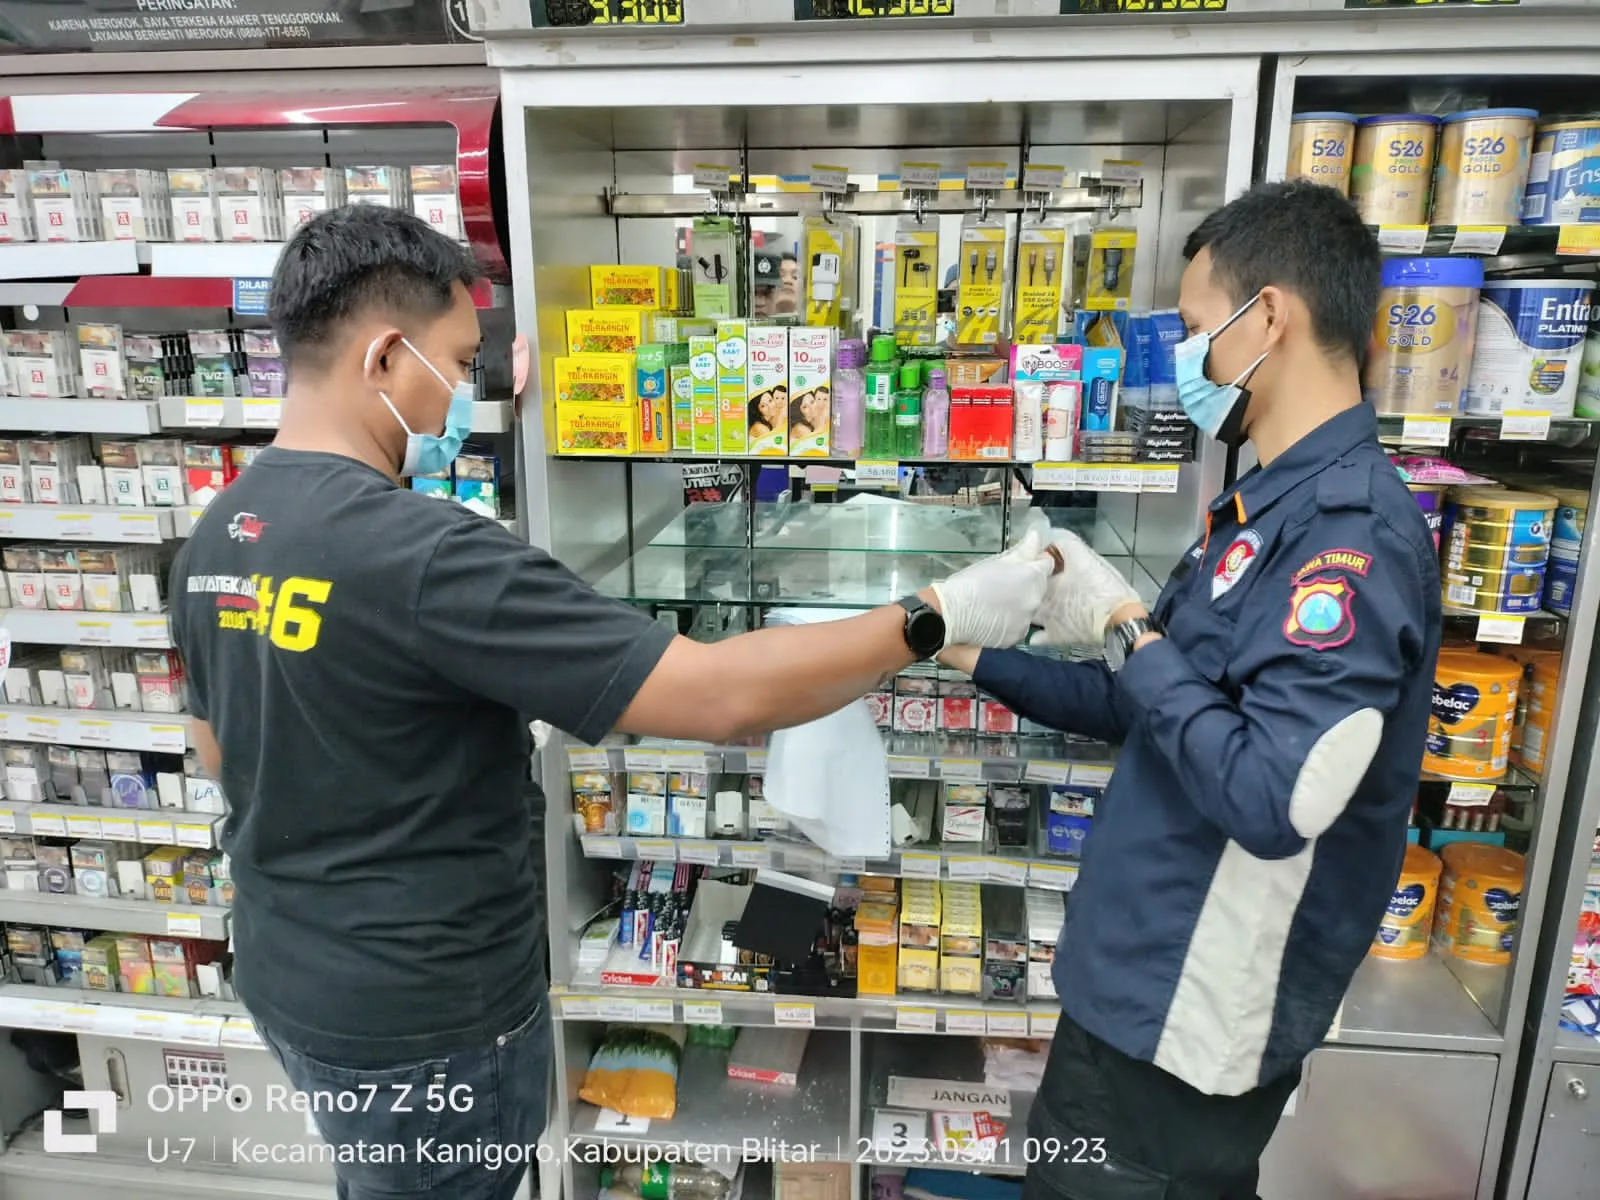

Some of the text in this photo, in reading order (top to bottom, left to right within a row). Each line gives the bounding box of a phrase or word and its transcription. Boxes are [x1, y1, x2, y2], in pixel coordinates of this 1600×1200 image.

[48, 18, 90, 31] KARENA
[143, 16, 169, 28] SAYA
[169, 15, 217, 27] TERKENA
[217, 14, 262, 26] KANKER
[88, 29, 134, 42] LAYANAN
[134, 29, 185, 41] BERHENTI
[184, 28, 235, 40] MEROKOK
[1311, 164, 1344, 174] GOLD
[1388, 164, 1421, 174] GOLD
[1463, 163, 1500, 173] GOLD
[1387, 335, 1432, 346] GOLD
[751, 350, 766, 361] 10
[794, 351, 809, 363] 10
[1323, 552, 1366, 571] TIMUR
[1431, 694, 1470, 710] ebelac
[931, 1088, 1007, 1105] JANGAN
